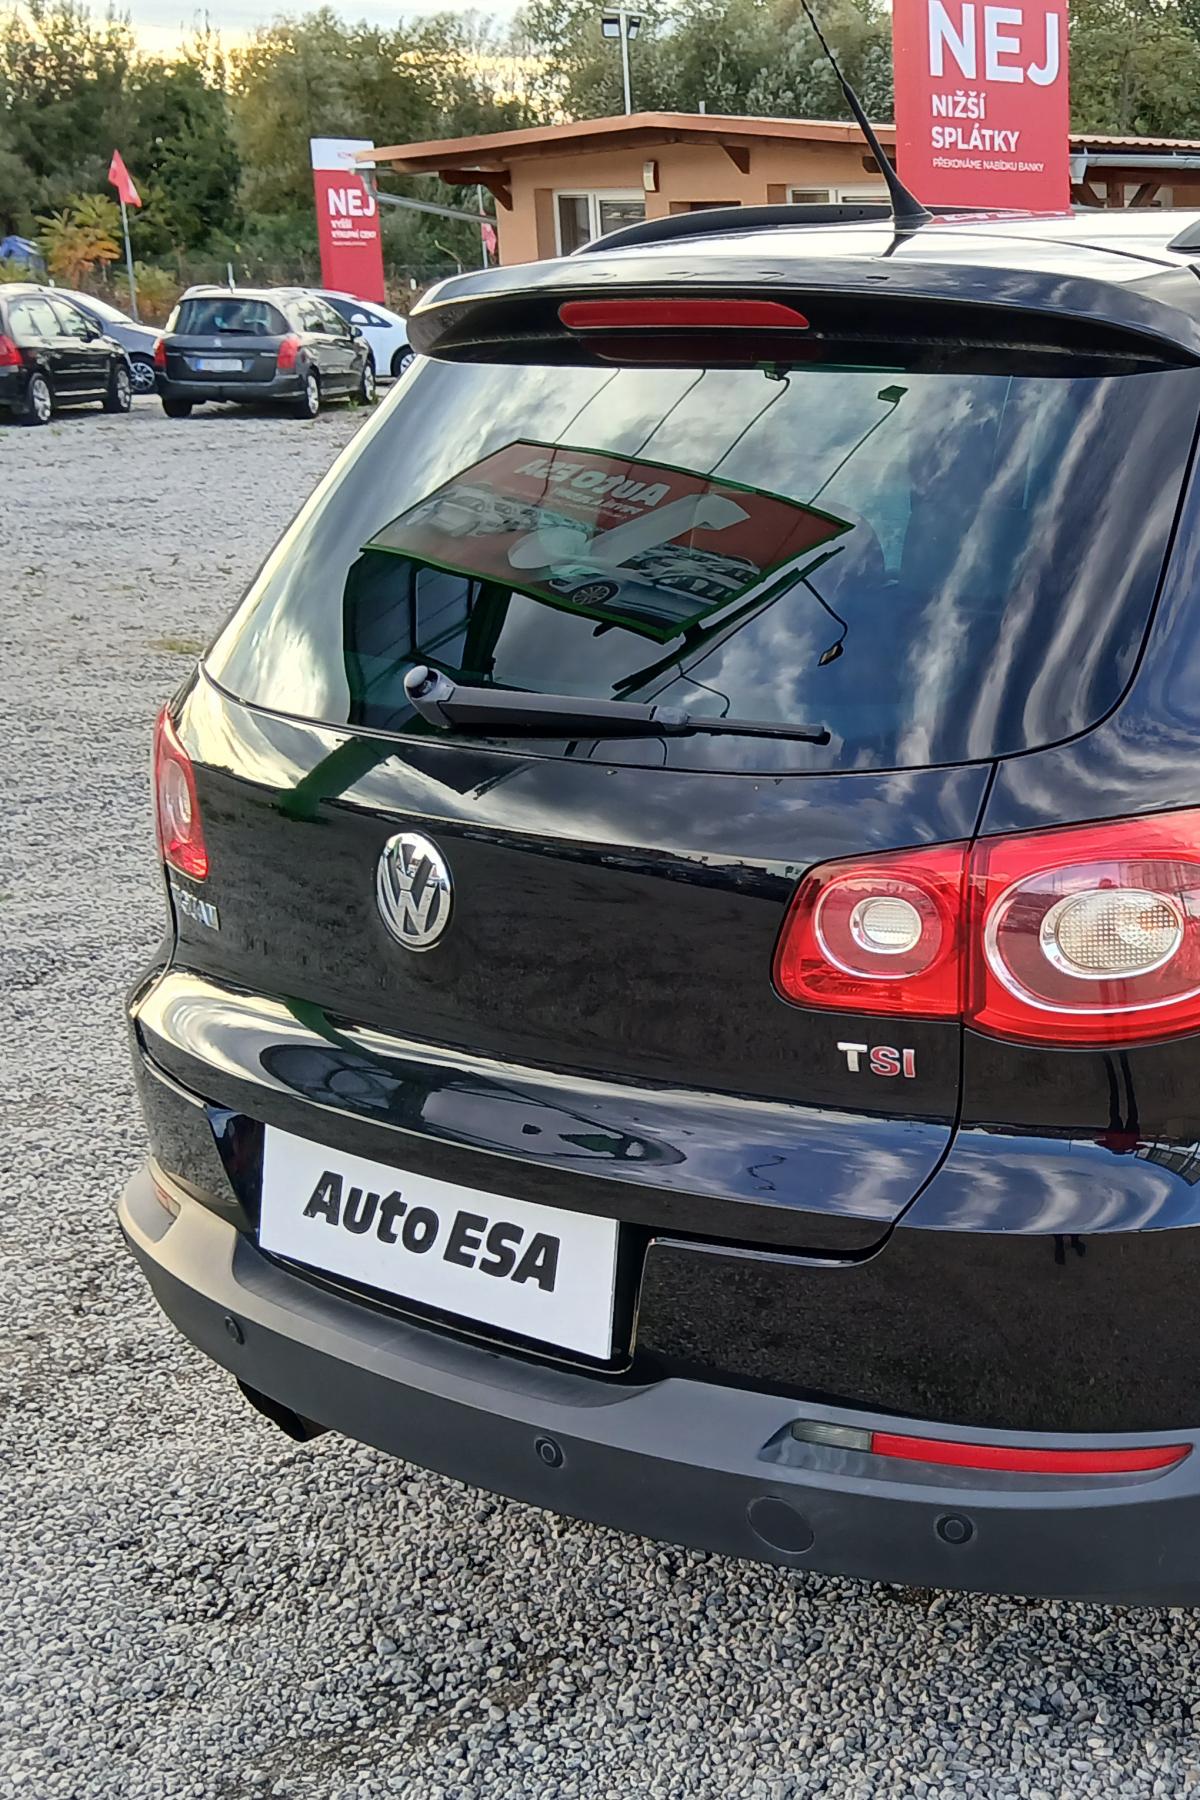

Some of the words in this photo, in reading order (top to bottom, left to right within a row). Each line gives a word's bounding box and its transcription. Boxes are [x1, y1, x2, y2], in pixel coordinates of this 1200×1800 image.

[928, 0, 1060, 87] NEJ
[931, 90, 987, 120] NIŽŠÍ
[931, 123, 1020, 153] SPLÁTKY
[1018, 162, 1044, 172] BANKY
[327, 187, 376, 217] NEJ
[837, 1042, 916, 1078] TSI
[302, 1170, 440, 1254] Auto
[443, 1210, 561, 1293] ESA
